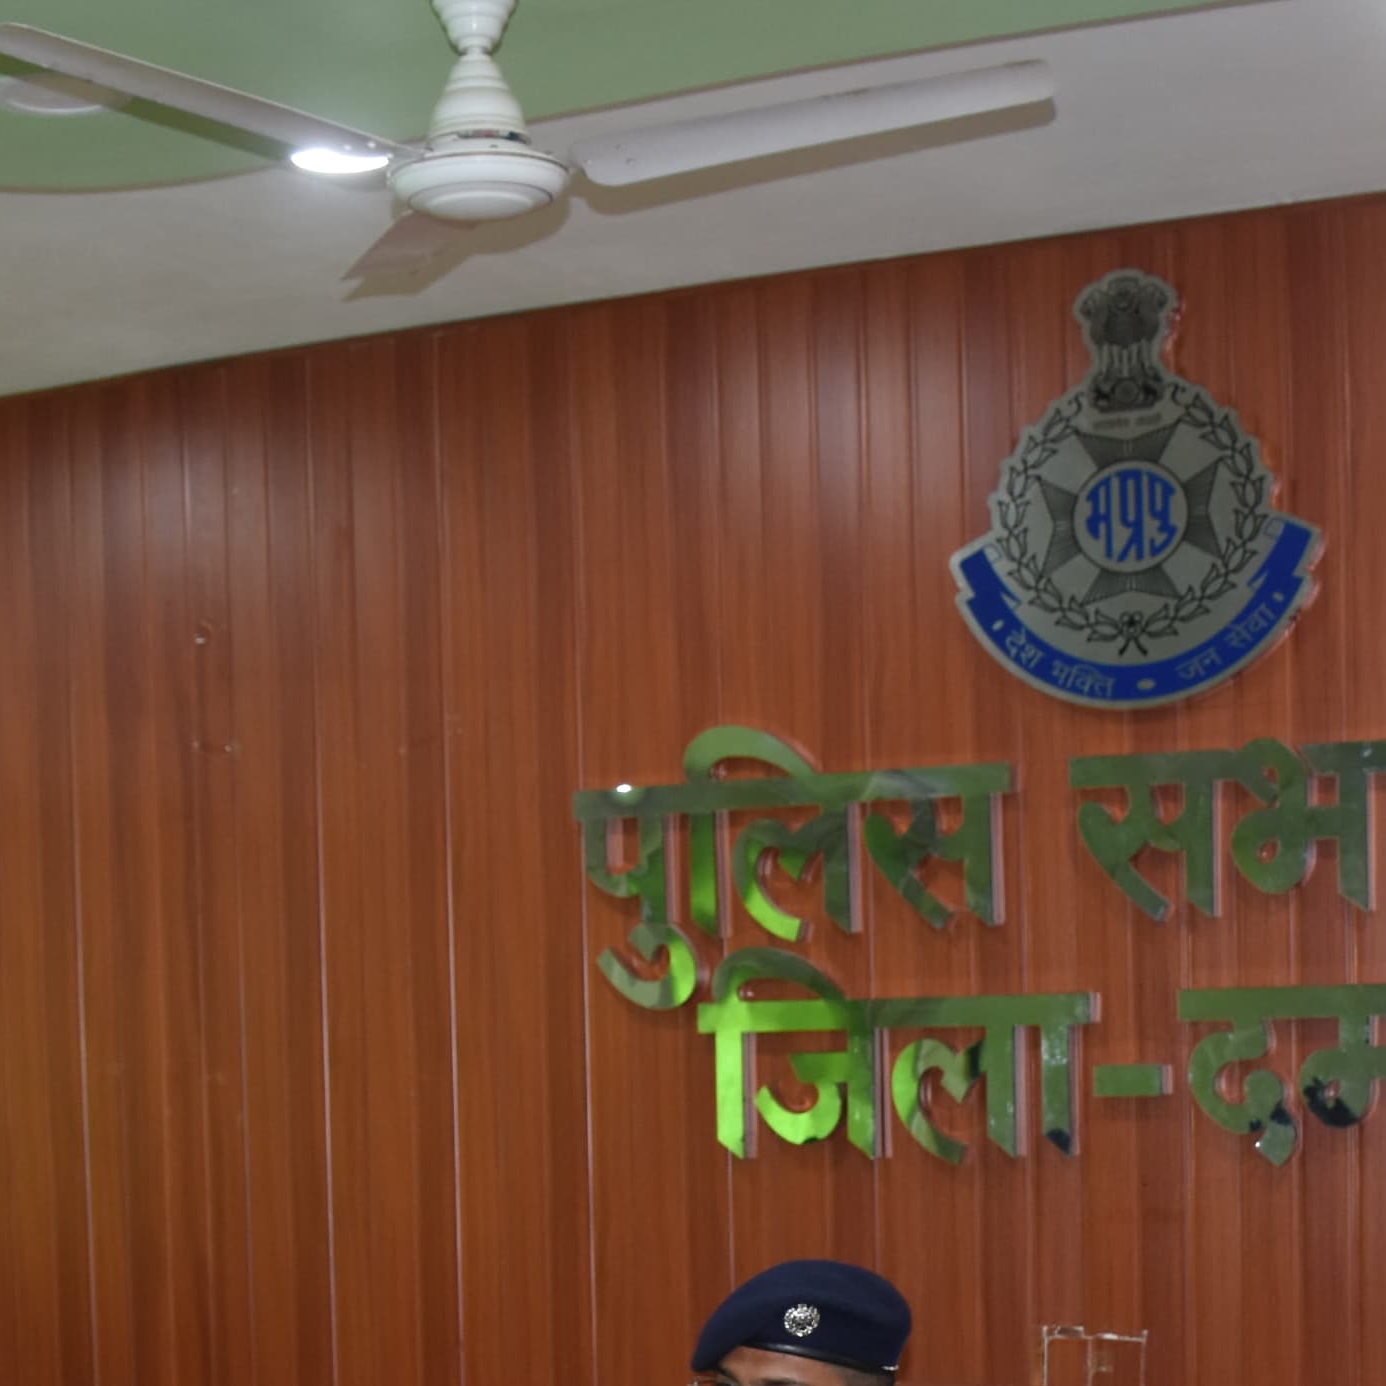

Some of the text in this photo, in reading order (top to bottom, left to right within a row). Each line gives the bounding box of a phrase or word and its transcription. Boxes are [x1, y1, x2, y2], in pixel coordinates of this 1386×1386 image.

[1004, 604, 1278, 698] देश भक्ति जन सेवा
[574, 724, 1011, 1009] पुलिस
